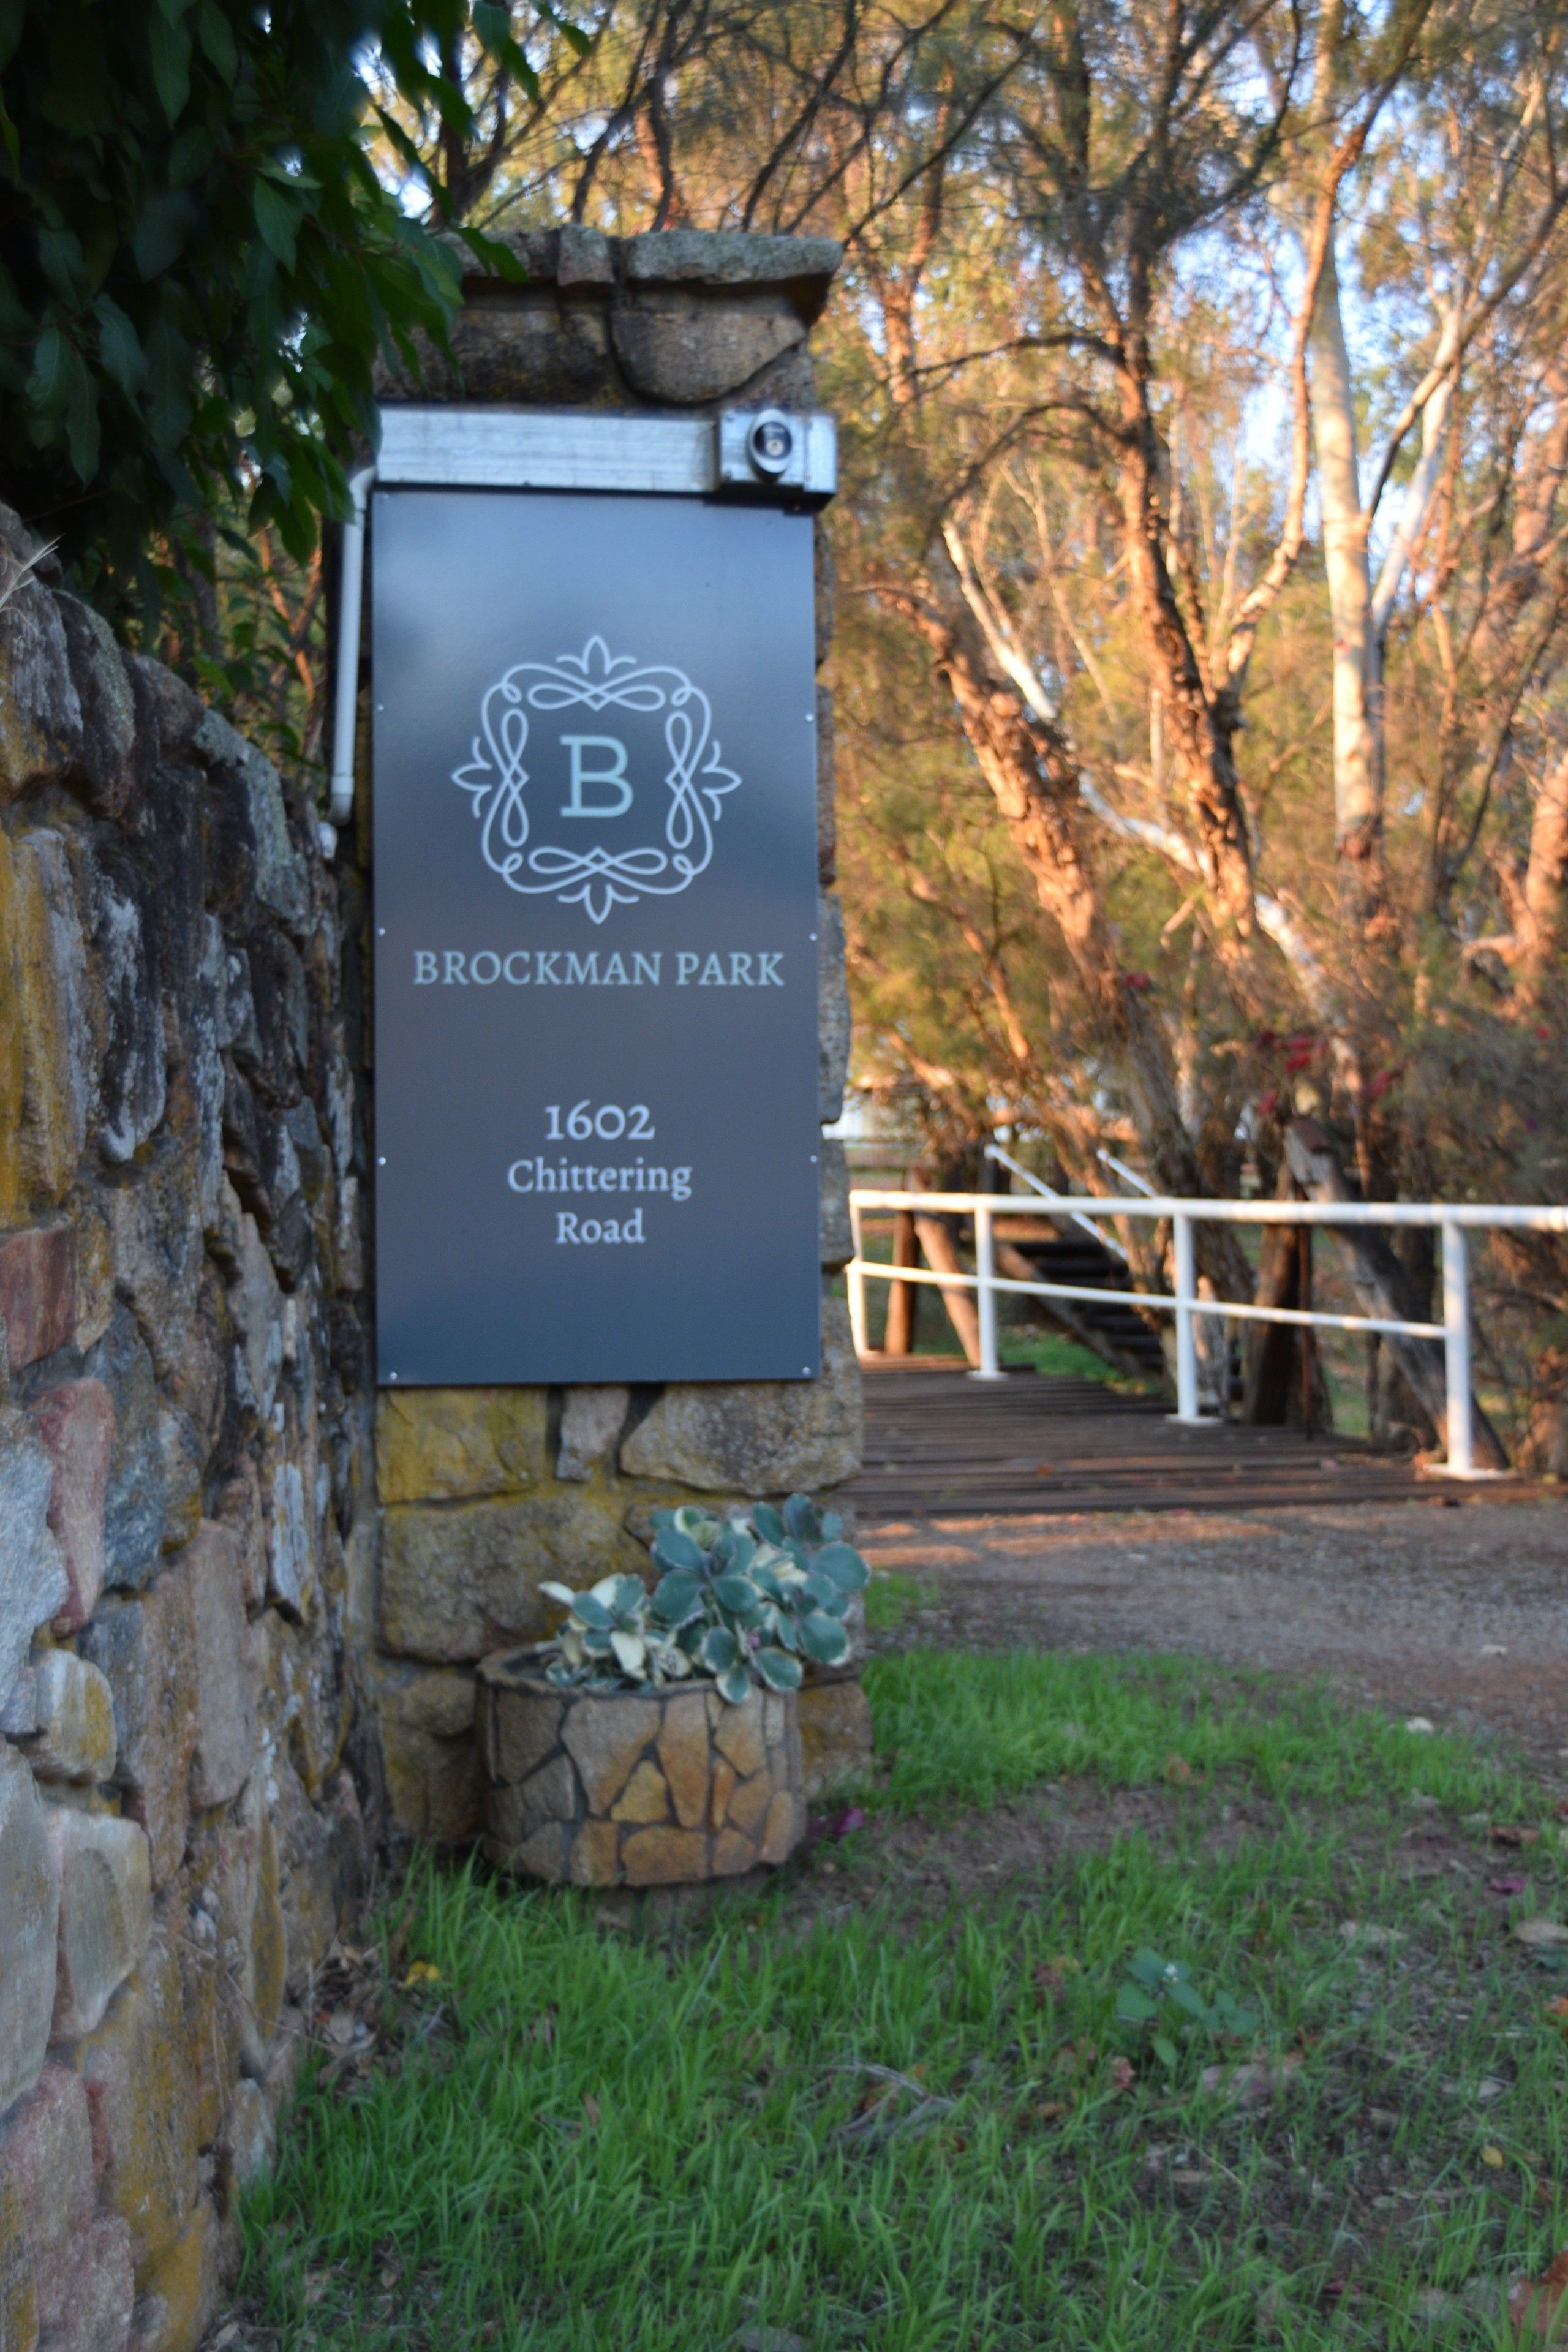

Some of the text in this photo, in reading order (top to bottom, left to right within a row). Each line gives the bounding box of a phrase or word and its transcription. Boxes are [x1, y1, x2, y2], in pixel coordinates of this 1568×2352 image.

[559, 734, 634, 818] B
[413, 950, 785, 986] BROCKMAN PARK
[544, 1099, 655, 1140] 1602
[507, 1155, 693, 1201] Chittering
[555, 1207, 646, 1244] Road
